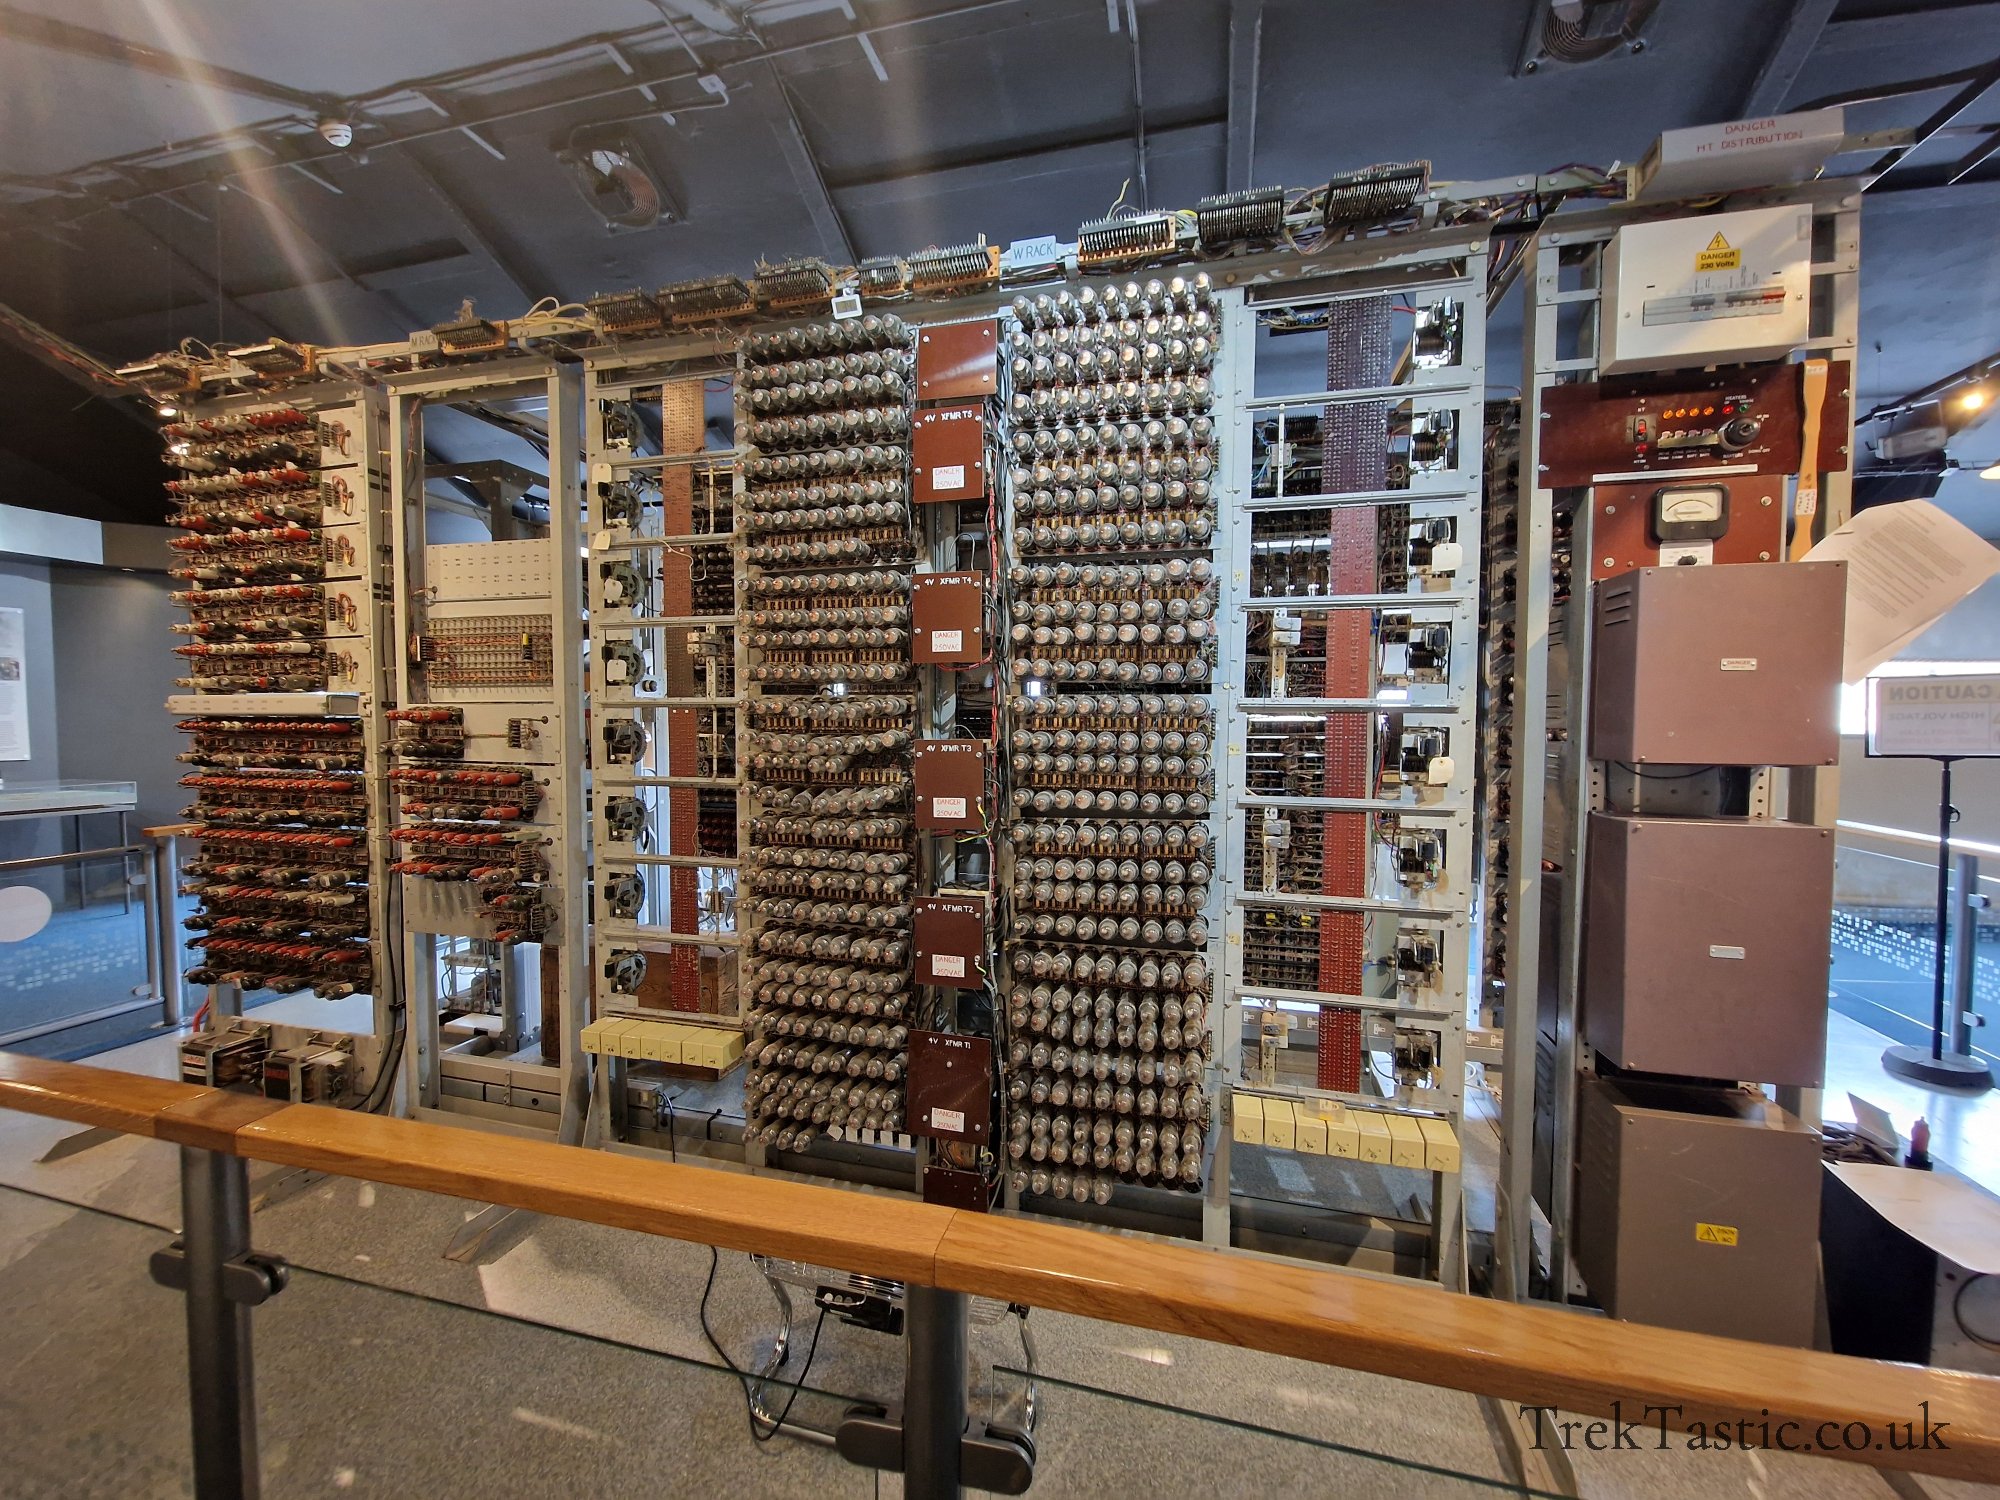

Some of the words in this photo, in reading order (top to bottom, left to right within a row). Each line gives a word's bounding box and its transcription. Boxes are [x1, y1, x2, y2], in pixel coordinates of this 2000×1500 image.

[1725, 120, 1776, 135] DANGER
[1697, 143, 1714, 152] HT
[1721, 130, 1803, 150] DISTRIBUTION
[1013, 247, 1024, 260] W
[1026, 242, 1053, 258] RACK
[1700, 251, 1735, 261] DANGER
[1716, 260, 1735, 268] Volts
[924, 413, 936, 423] 4V
[941, 411, 962, 421] XFMR
[962, 410, 973, 419] T5
[935, 467, 960, 476] DANGER
[924, 578, 935, 586] 4V
[939, 577, 960, 585] XFMR
[961, 576, 972, 585] T4
[934, 631, 959, 639] DANGER
[926, 744, 936, 752] 4V
[941, 744, 960, 752] XFMR
[961, 744, 972, 752] T3
[941, 904, 962, 913] XFMR
[962, 905, 975, 914] T2
[935, 955, 961, 964] DANGER
[945, 1039, 963, 1048] XFMR
[963, 1041, 971, 1049] T1
[934, 1108, 961, 1120] DANGER
